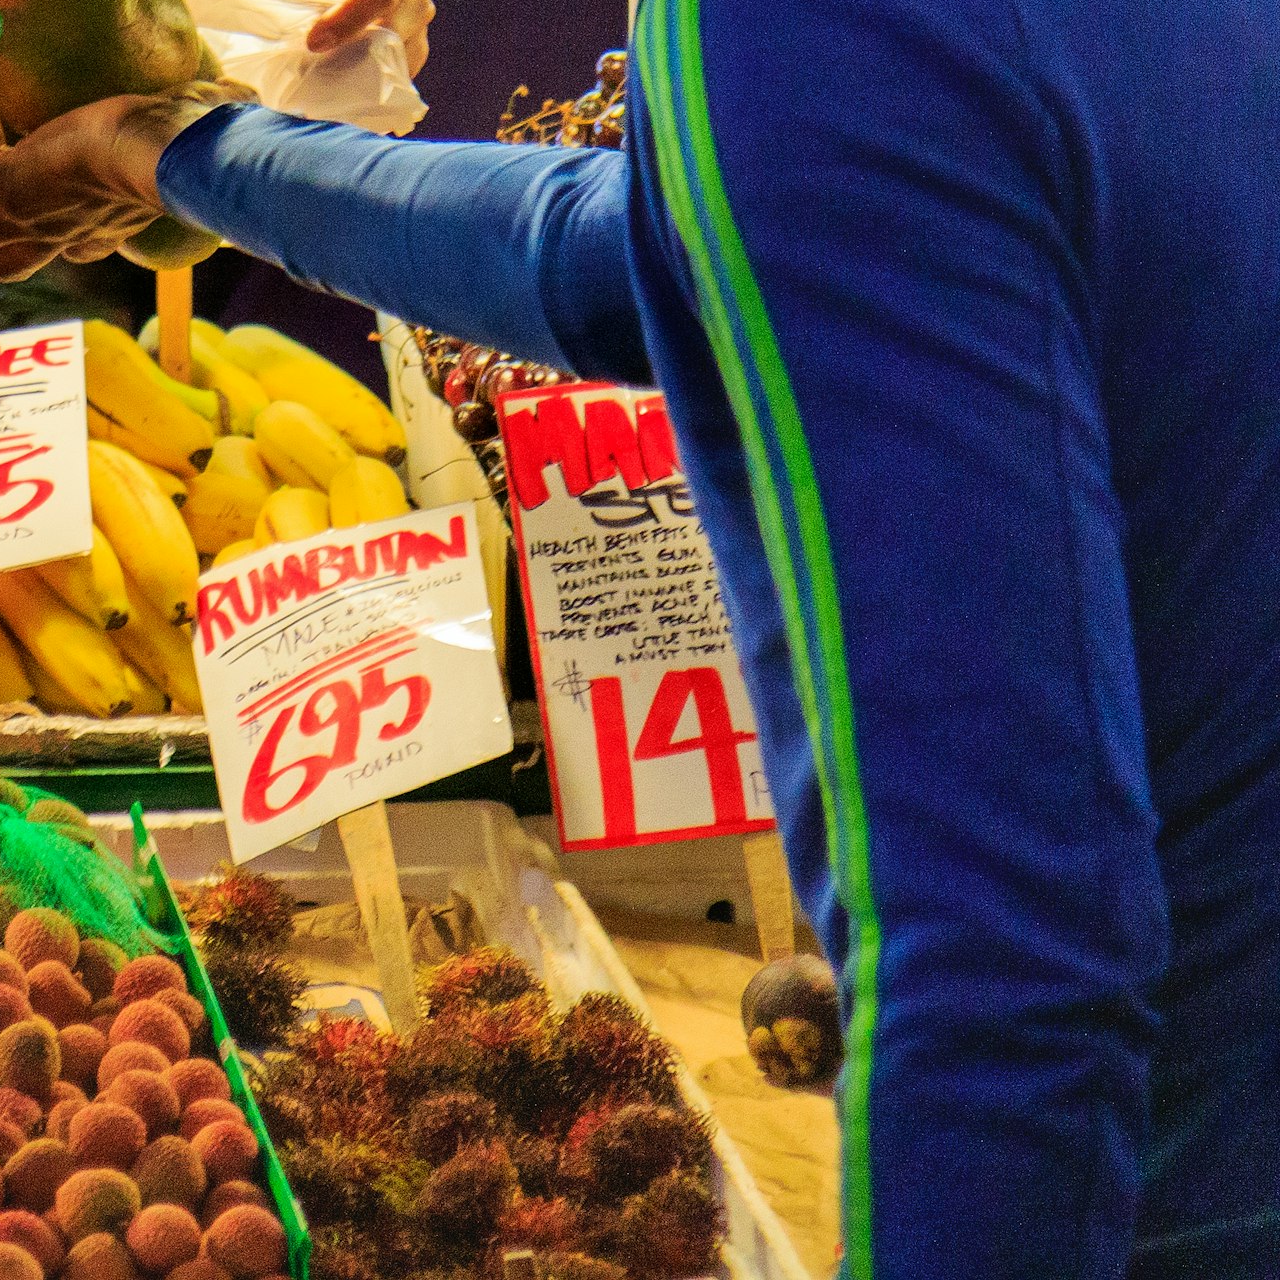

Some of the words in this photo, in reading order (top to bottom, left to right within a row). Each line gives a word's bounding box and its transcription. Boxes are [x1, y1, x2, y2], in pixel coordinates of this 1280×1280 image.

[196, 514, 468, 657] RUMBUTAN
[530, 535, 597, 560] HEALTH
[603, 524, 689, 552] BENEFITS
